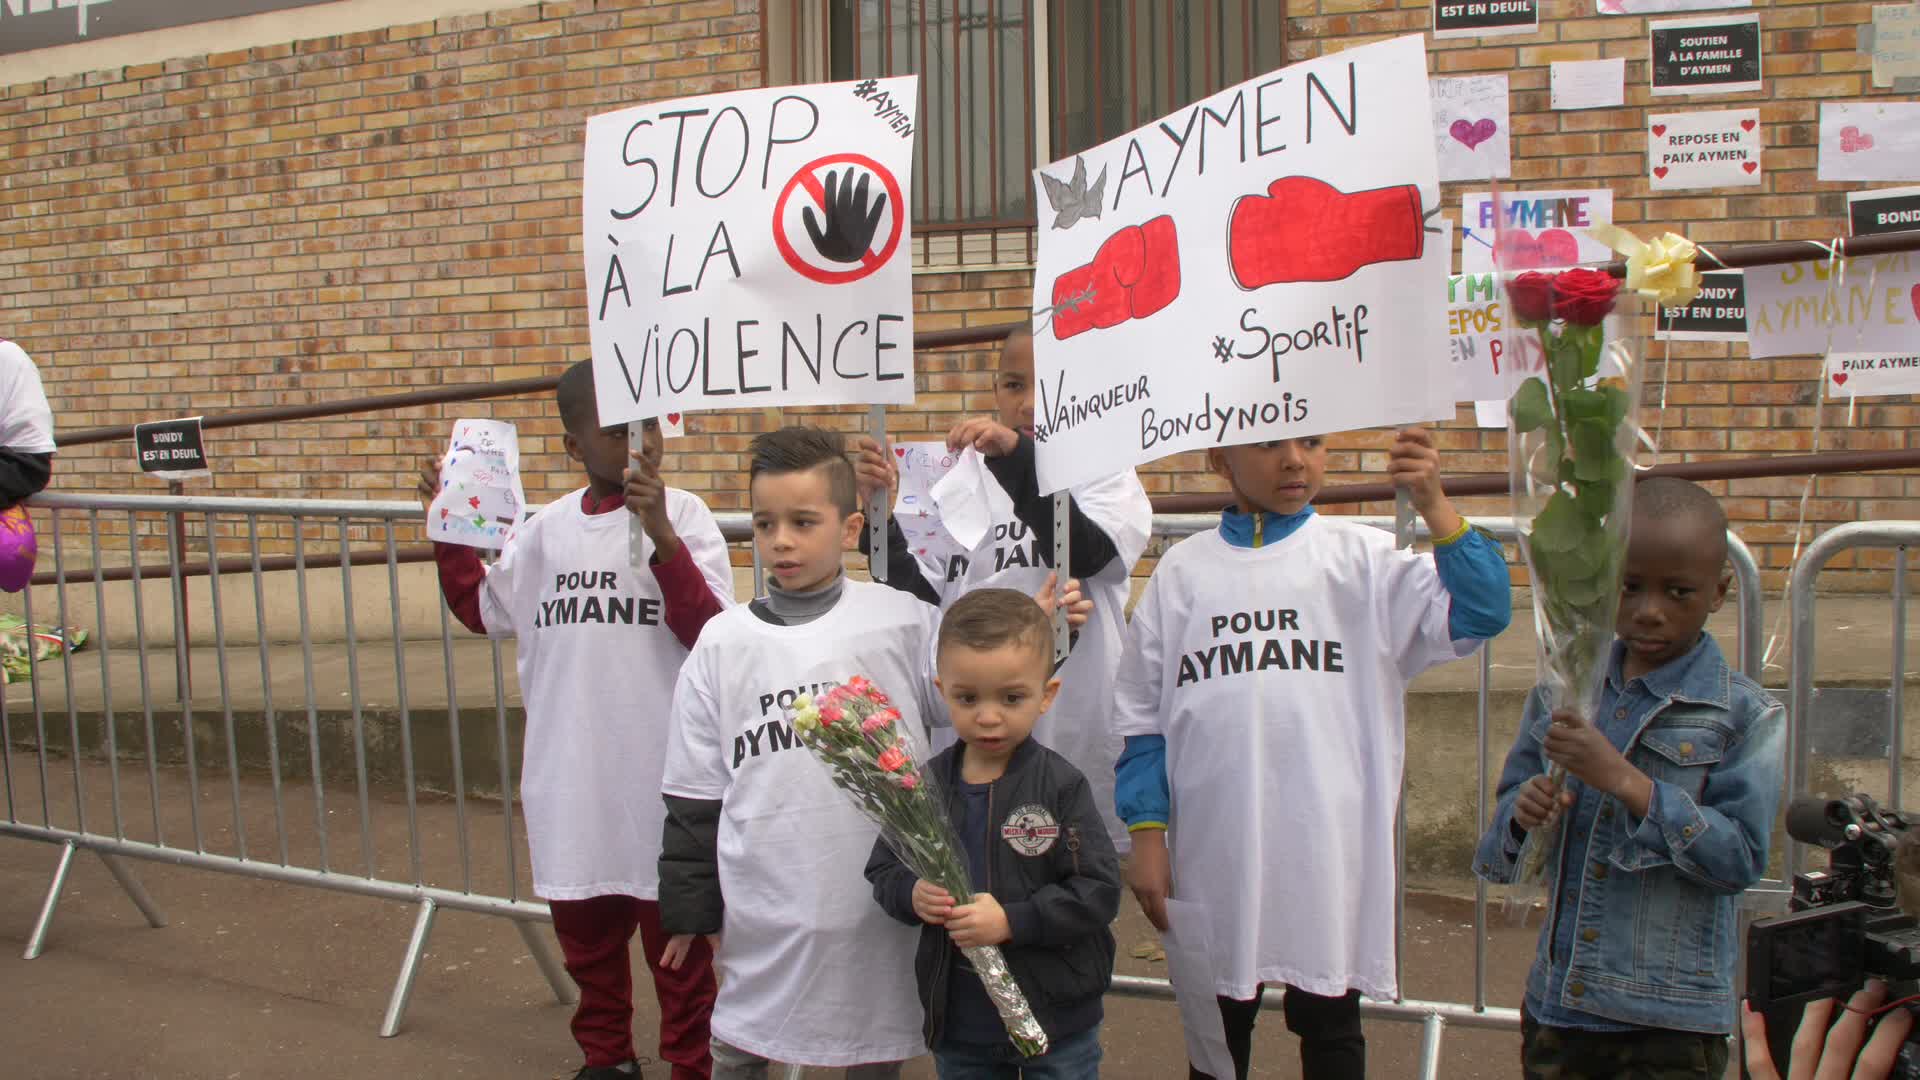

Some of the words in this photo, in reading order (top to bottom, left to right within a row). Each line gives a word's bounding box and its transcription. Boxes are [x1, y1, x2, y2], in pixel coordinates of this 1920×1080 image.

[1441, 5, 1464, 17] EST
[1468, 3, 1486, 15] EN
[1490, 0, 1531, 14] DEUIL
[1680, 36, 1728, 47] SOUTIEN
[1669, 51, 1677, 62] À
[1680, 52, 1693, 61] LA
[1696, 49, 1742, 60] FAMILLE
[1681, 65, 1731, 75] D'AYMEN
[853, 79, 914, 139] #AYMEN
[1113, 62, 1355, 211] AYMEN
[1669, 133, 1718, 146] REPOSE
[1722, 132, 1740, 143] EN
[610, 95, 819, 220] STOP
[1663, 153, 1694, 164] PAIX
[1698, 150, 1747, 162] AYMEN
[1877, 210, 1920, 225] BOND
[599, 234, 632, 321] À
[662, 220, 742, 297] LA
[1695, 287, 1737, 300] ONDY
[1664, 307, 1688, 318] EST
[1692, 307, 1711, 318] EN
[1715, 307, 1744, 319] DEU
[1842, 361, 1874, 371] PAIX
[1879, 357, 1920, 368] AYME
[171, 448, 200, 459] DEUIL
[556, 571, 617, 592] POUR
[534, 596, 661, 629] AYMANE
[1212, 609, 1300, 638] POUR
[1177, 639, 1345, 688] AYMANE
